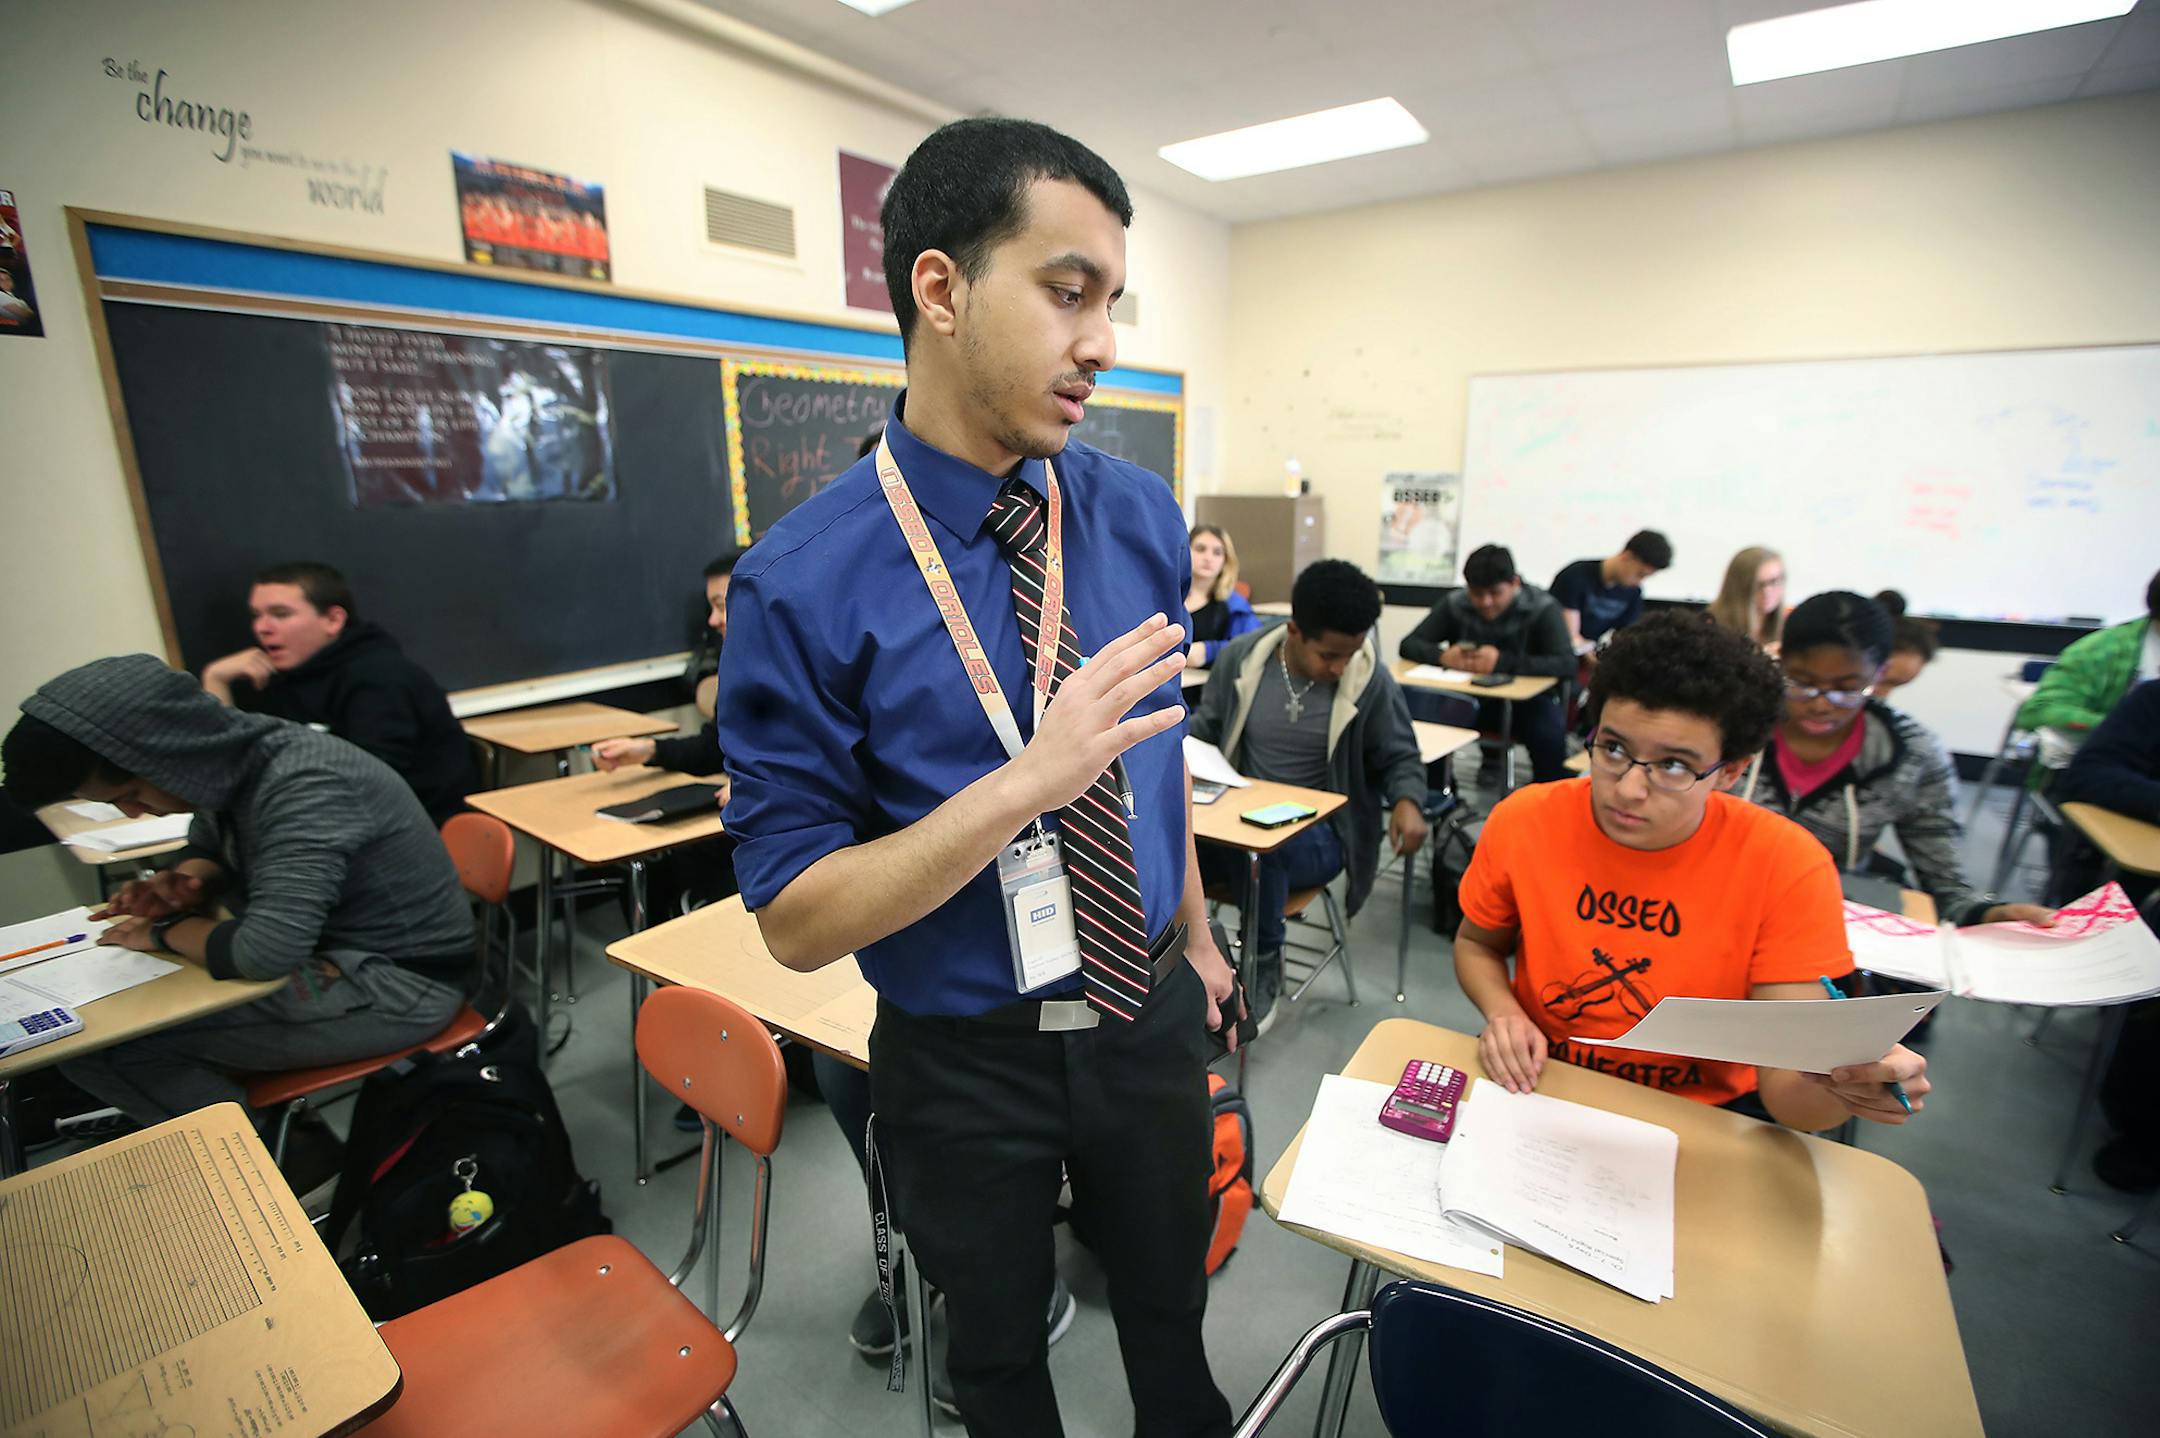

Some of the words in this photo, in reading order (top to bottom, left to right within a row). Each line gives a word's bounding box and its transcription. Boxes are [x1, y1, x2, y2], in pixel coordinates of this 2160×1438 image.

[101, 57, 125, 80] Be
[127, 59, 149, 84] the
[136, 68, 253, 163] change
[306, 162, 389, 216] world
[740, 378, 888, 434] Geometry
[752, 432, 833, 496] Right
[879, 466, 934, 553] OSSEO
[930, 580, 999, 695] ORIOLES
[1035, 571, 1062, 696] ORIOLES
[1032, 906, 1055, 922] HID
[1576, 883, 1681, 938] OSSEO
[874, 1212, 887, 1253] CLASS
[879, 1258, 888, 1277] OF
